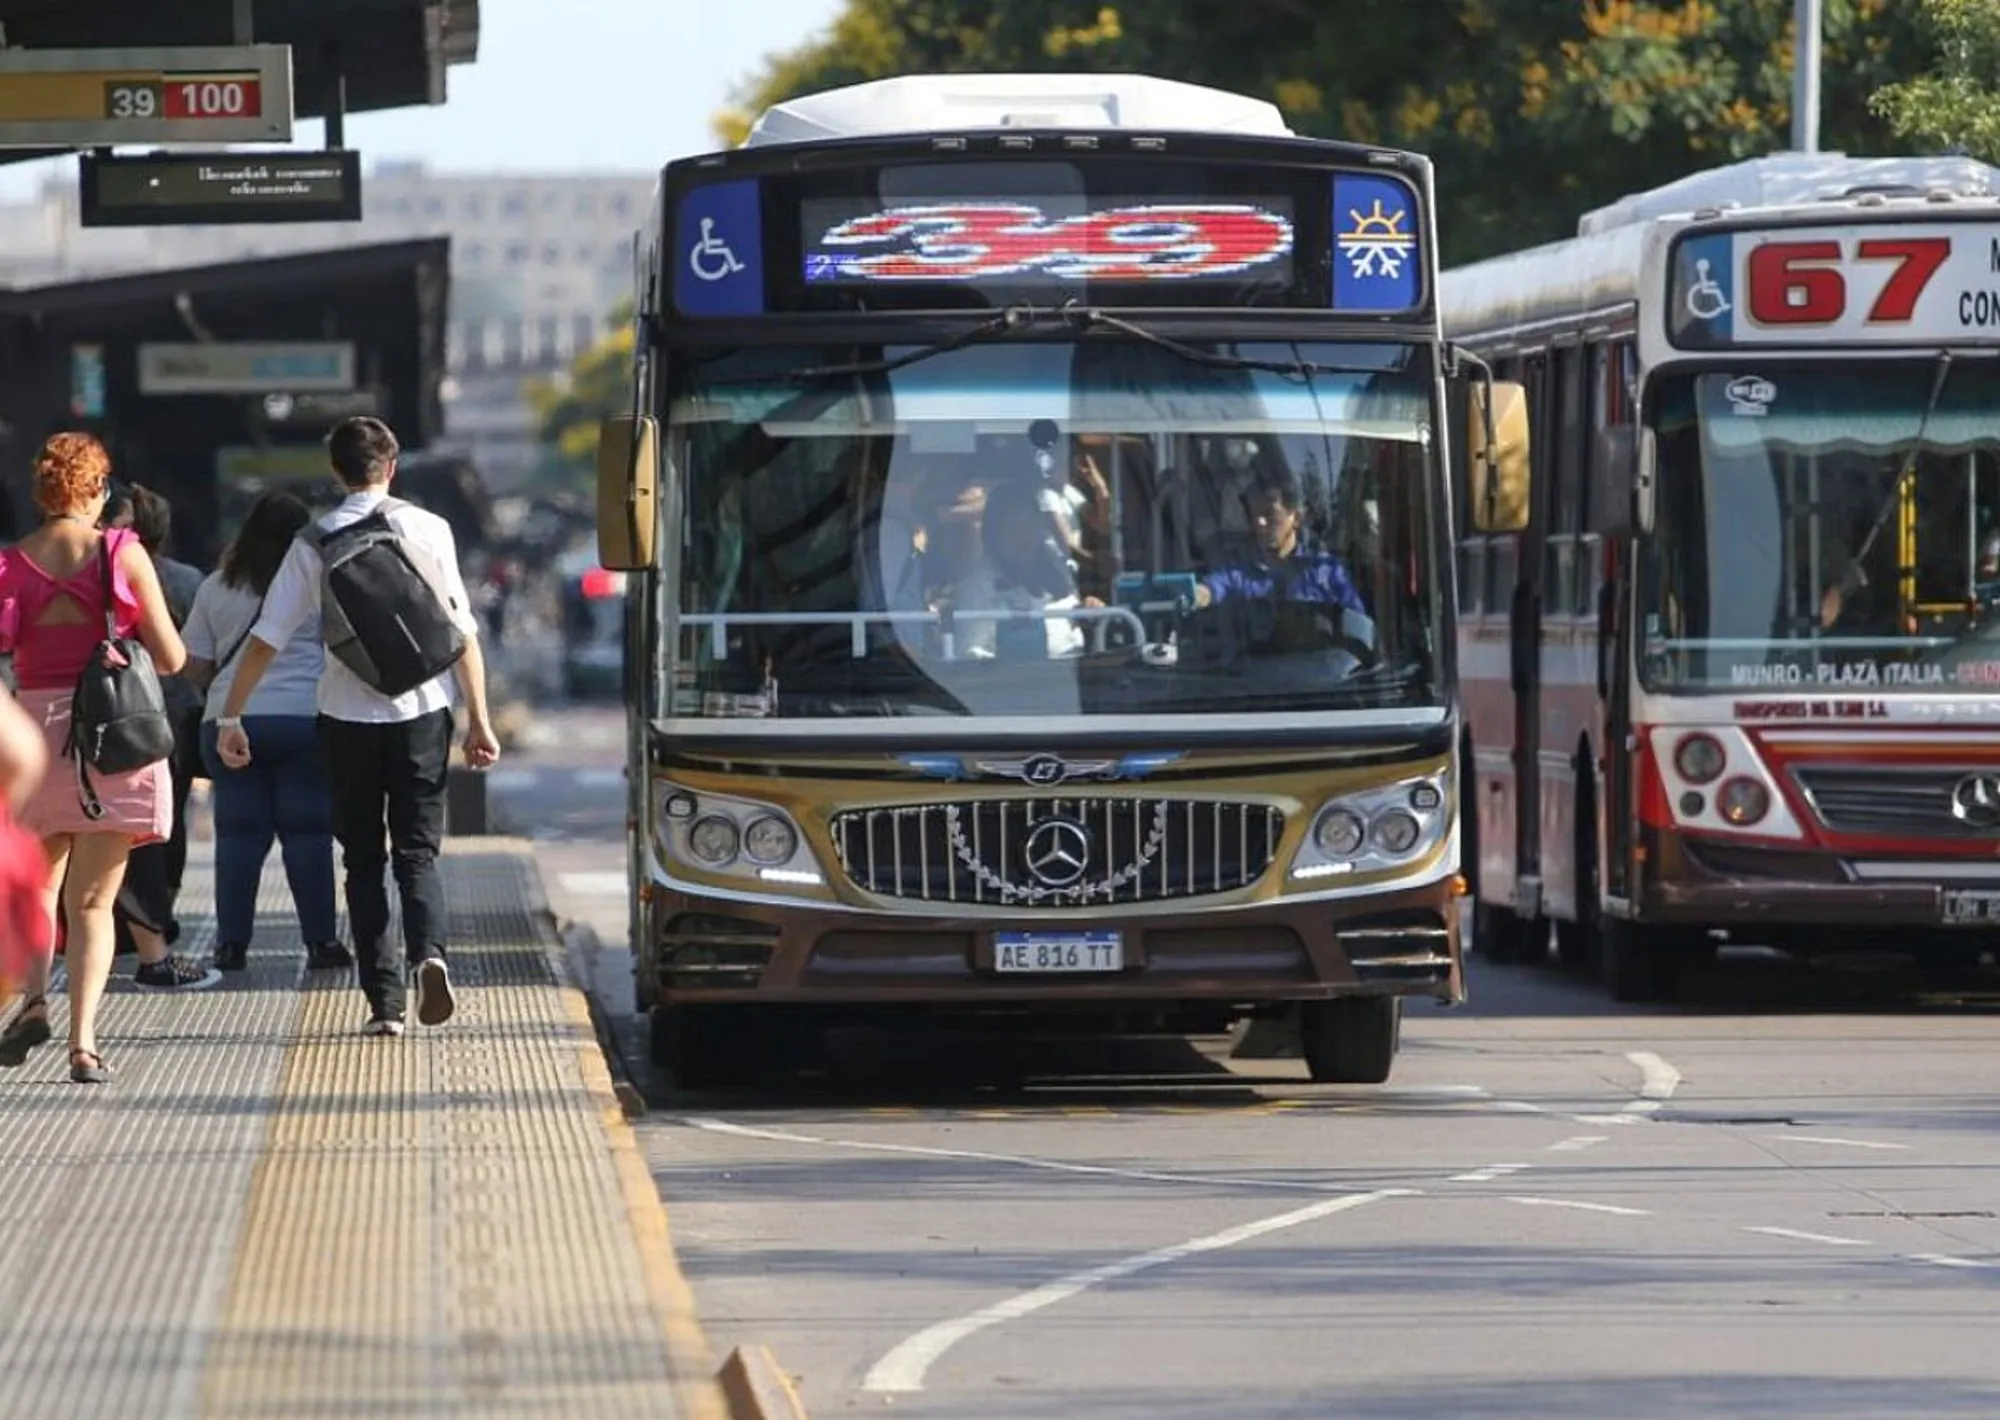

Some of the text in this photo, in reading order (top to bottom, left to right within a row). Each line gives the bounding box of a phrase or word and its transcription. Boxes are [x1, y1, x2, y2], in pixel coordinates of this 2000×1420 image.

[113, 83, 243, 116] 39 100
[821, 203, 1293, 279] 39
[1746, 237, 1952, 326] 67
[1731, 664, 1799, 685] MUNRO
[1816, 663, 1879, 686] PLAZA
[1883, 663, 1943, 685] ITALIA
[1001, 944, 1114, 968] AE 816 TT
